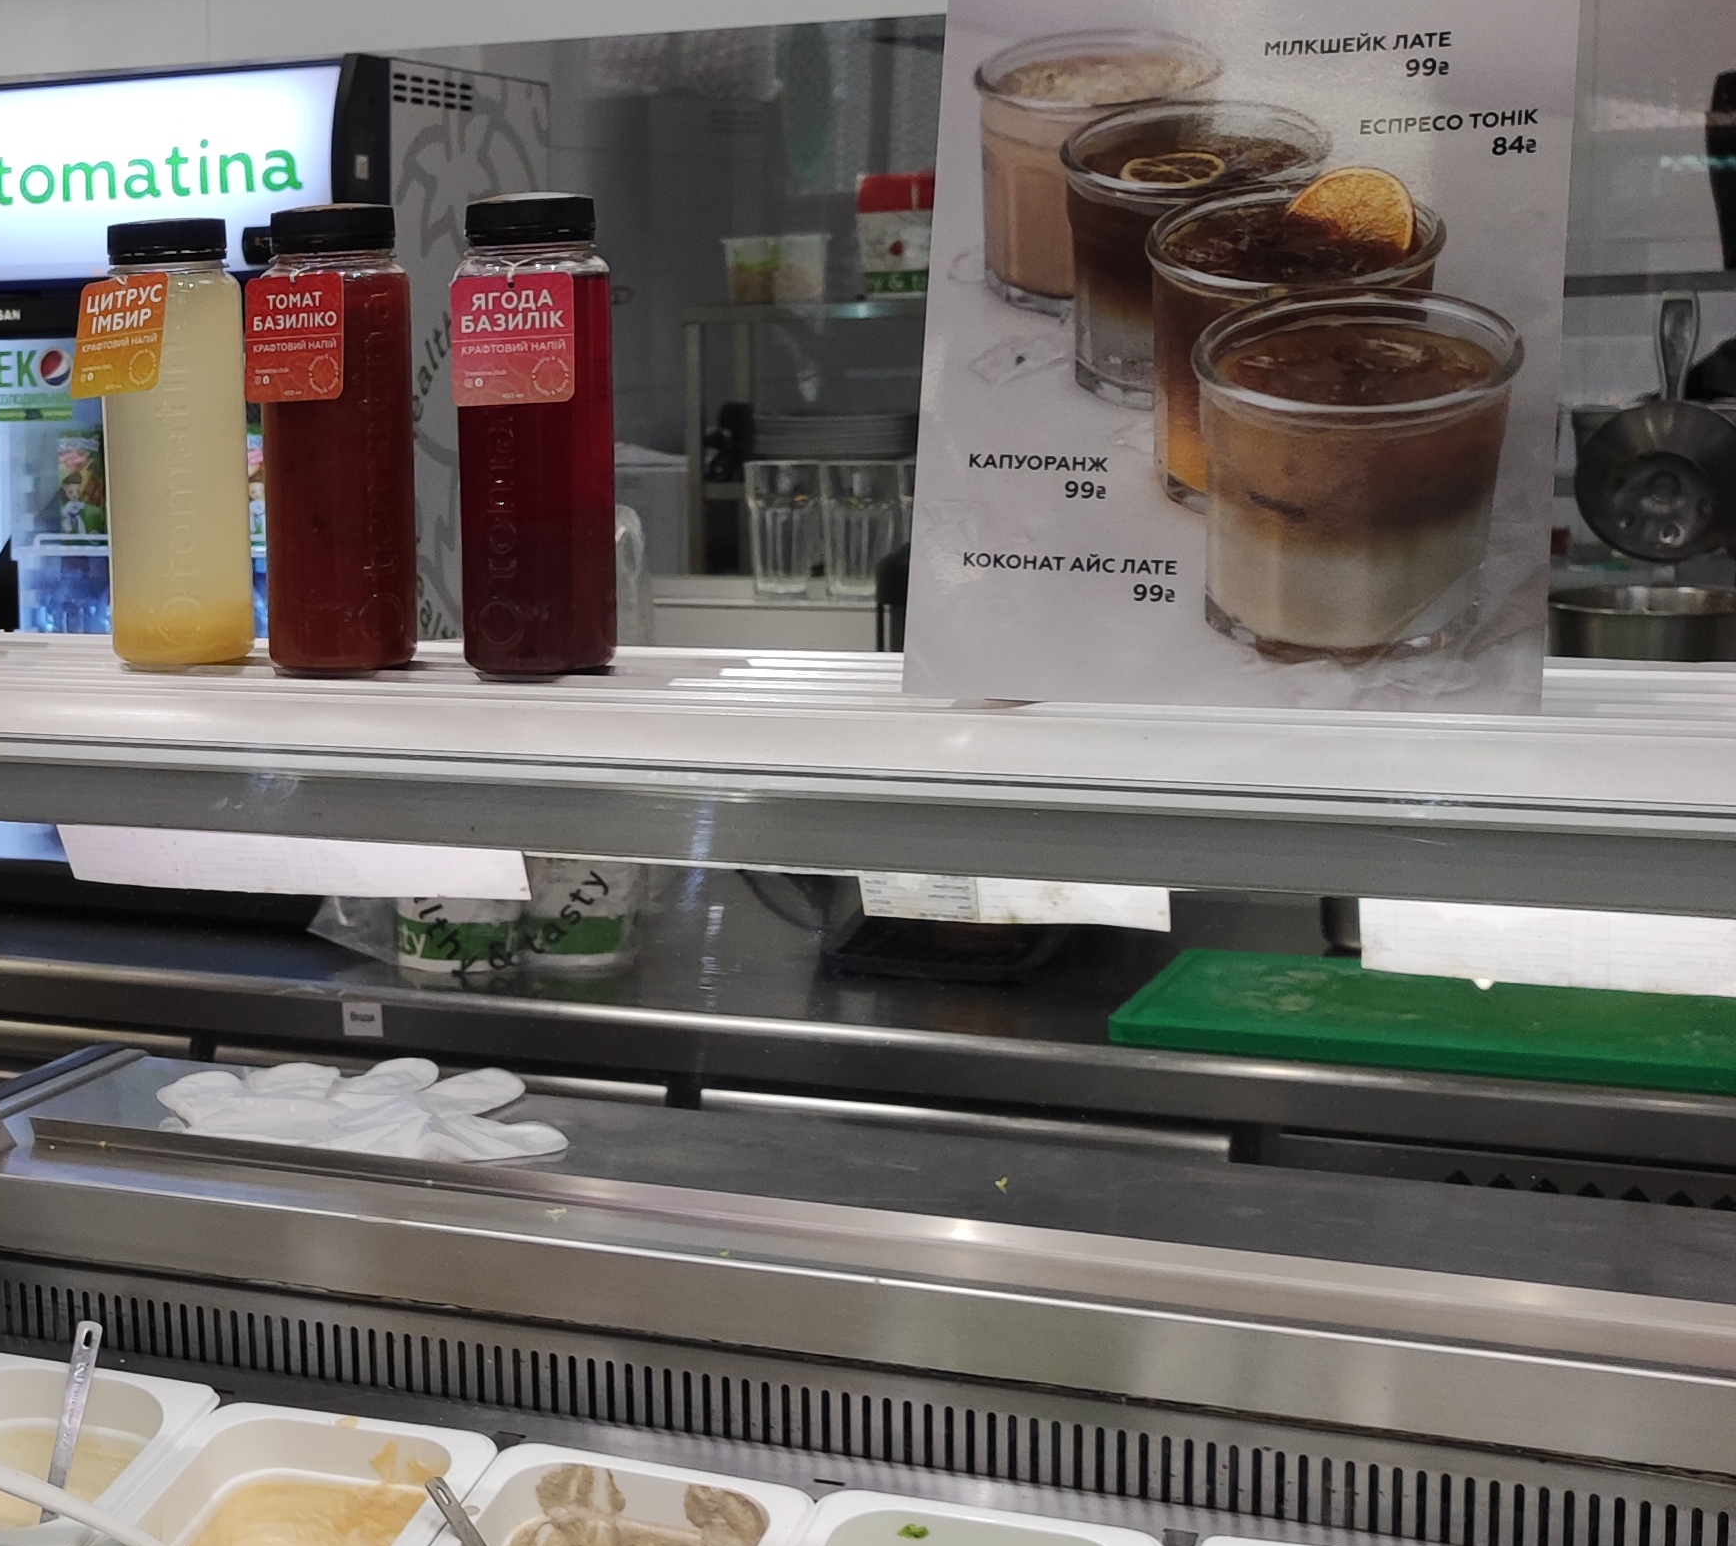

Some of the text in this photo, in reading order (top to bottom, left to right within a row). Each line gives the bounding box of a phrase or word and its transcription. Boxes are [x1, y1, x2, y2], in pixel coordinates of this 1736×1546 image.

[1264, 31, 1452, 57] МІЛКШЕЙК ЛАТЕ
[1359, 108, 1539, 136] ЕСПРЕСО ТОНІК
[86, 283, 164, 316] ЦИТРУС
[266, 291, 323, 311] ТОМАТ
[471, 289, 553, 312] ЯГОДА
[90, 308, 152, 335] ІМБИР
[252, 311, 338, 333] БАЗИЛІКО
[461, 310, 565, 334] БАЗИЛІК
[968, 453, 1108, 473] КАПУОРАНЖ
[962, 552, 1178, 577] КОКОНАТ АЙС ЛАТЕ
